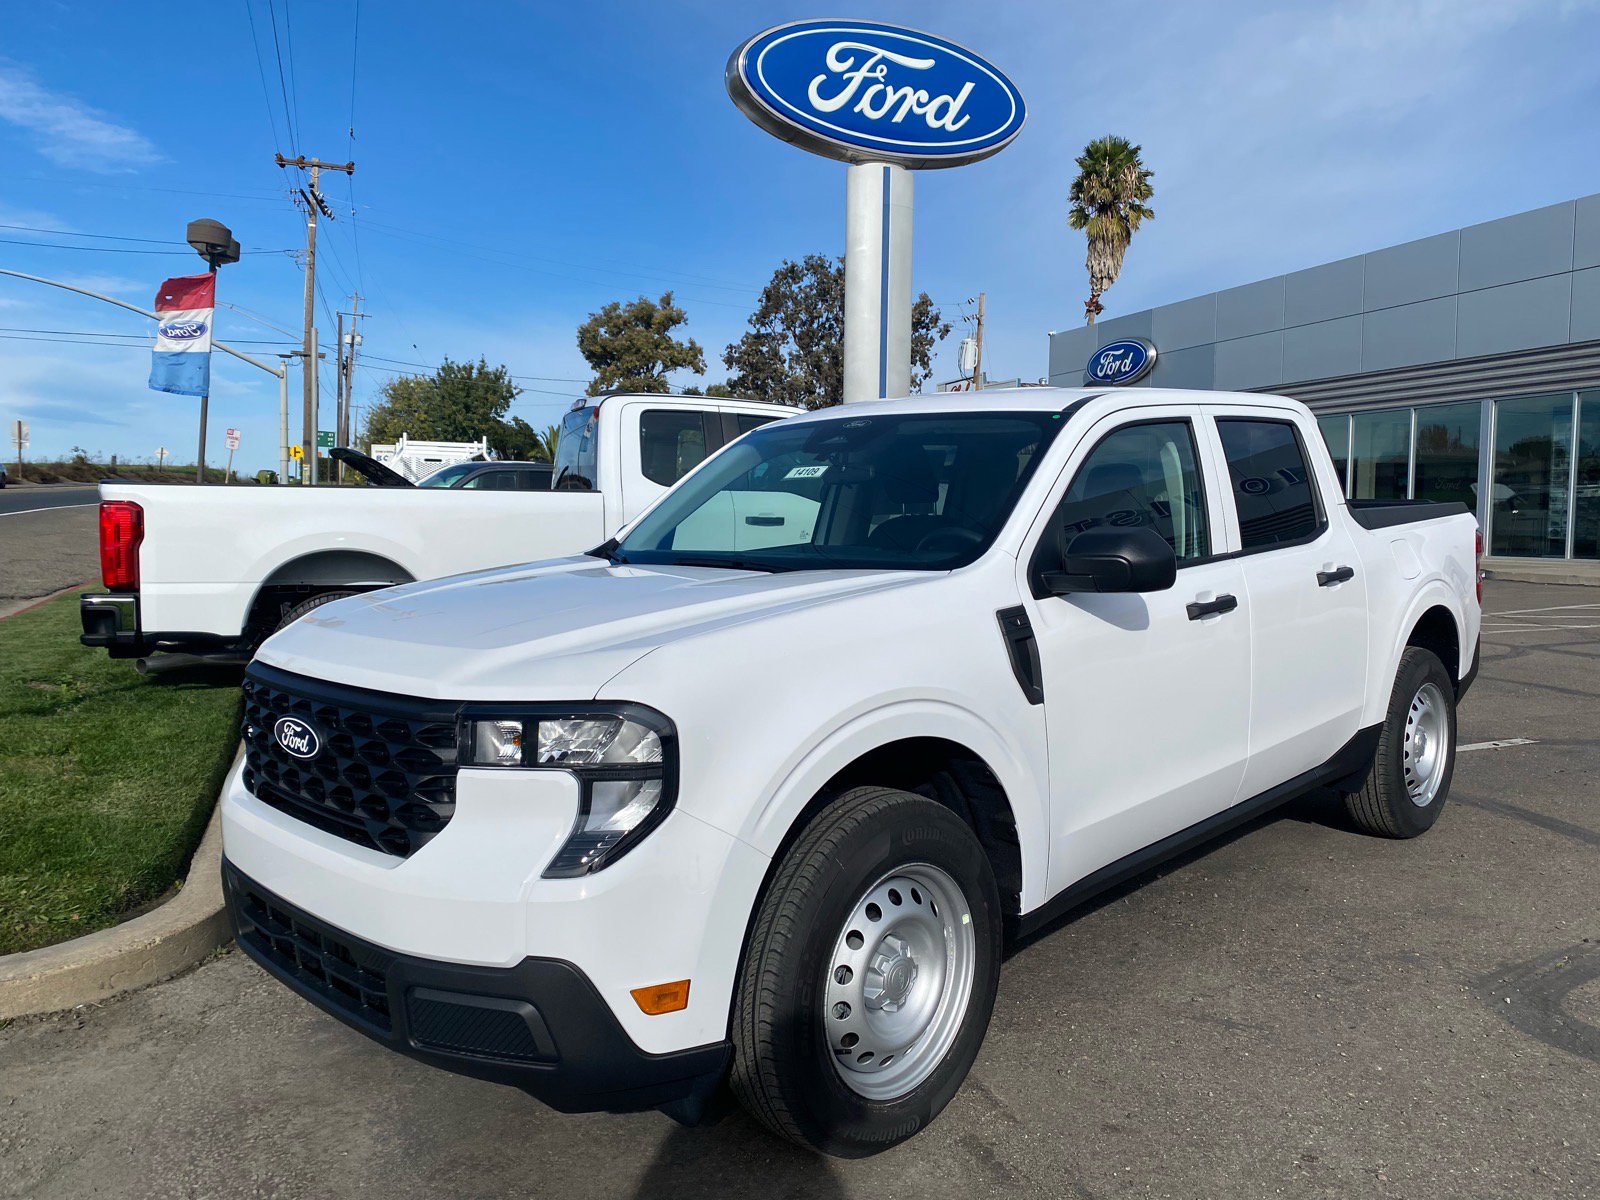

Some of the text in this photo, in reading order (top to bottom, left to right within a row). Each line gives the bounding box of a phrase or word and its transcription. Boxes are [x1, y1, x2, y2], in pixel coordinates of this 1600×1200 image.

[807, 41, 975, 132] Ford
[1097, 348, 1133, 377] Ford
[793, 467, 820, 477] 14109
[282, 722, 309, 753] Ford
